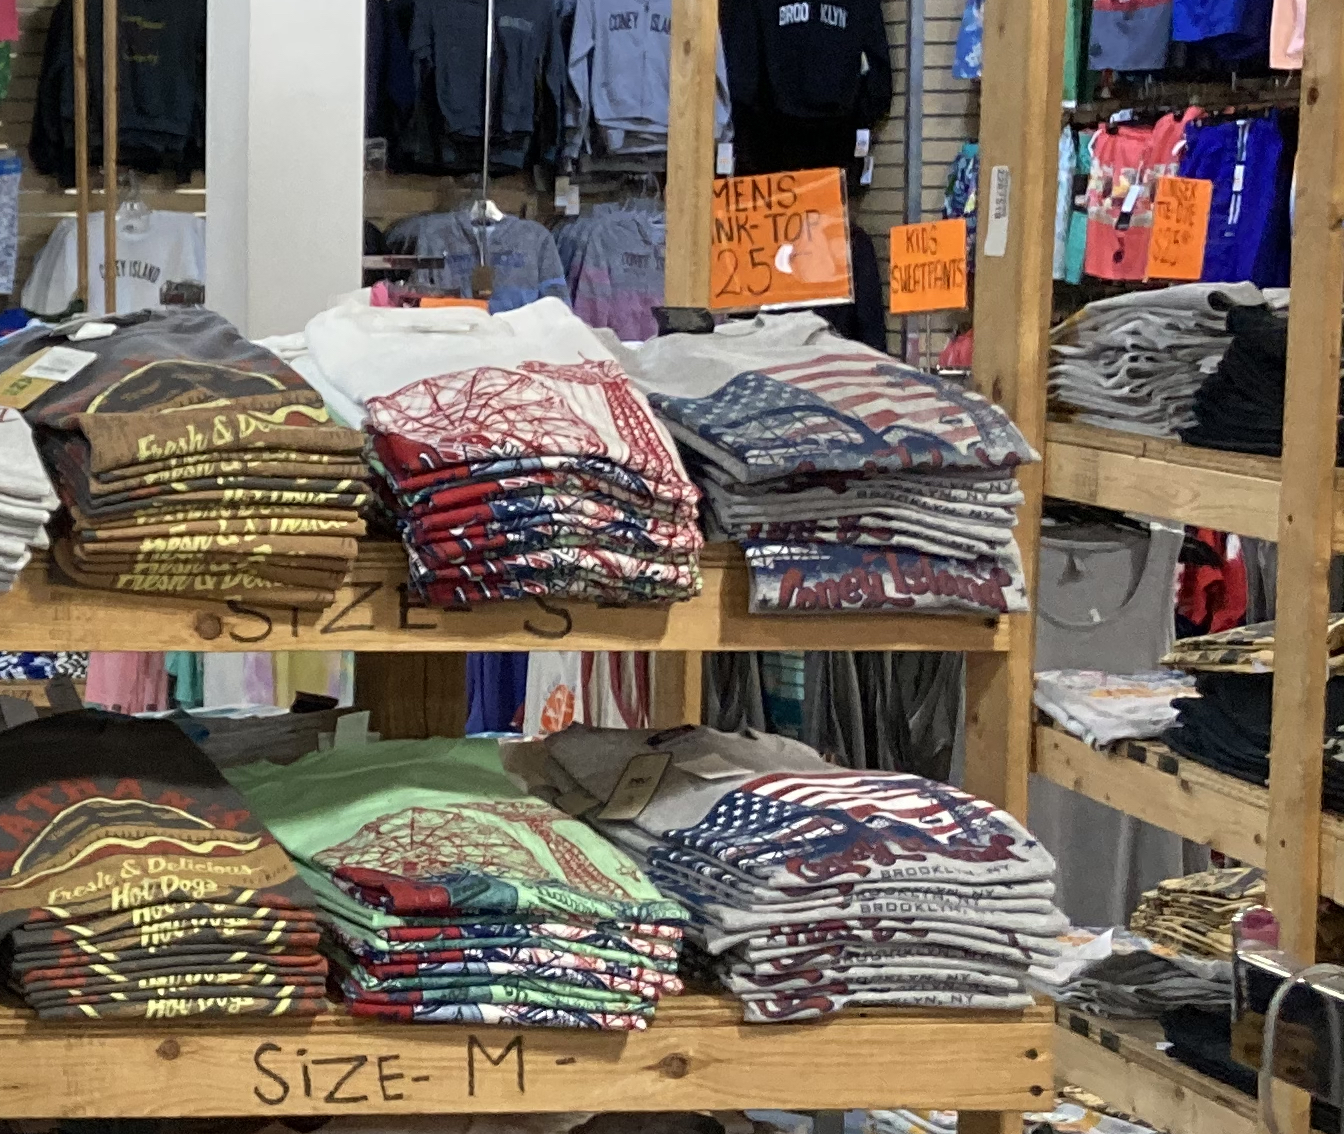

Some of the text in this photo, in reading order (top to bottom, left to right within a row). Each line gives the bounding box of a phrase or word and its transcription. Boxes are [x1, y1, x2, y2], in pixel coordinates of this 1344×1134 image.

[609, 11, 672, 35] CONEY ISLA
[820, 2, 849, 29] KLYN
[713, 174, 798, 213] MENS
[712, 209, 821, 246] NK-TOP
[905, 224, 939, 255] KIDS
[99, 259, 126, 280] CEY
[716, 247, 773, 299] 25
[48, 857, 253, 904] Fresh & Delicious
[111, 874, 218, 910] Hot Dogs
